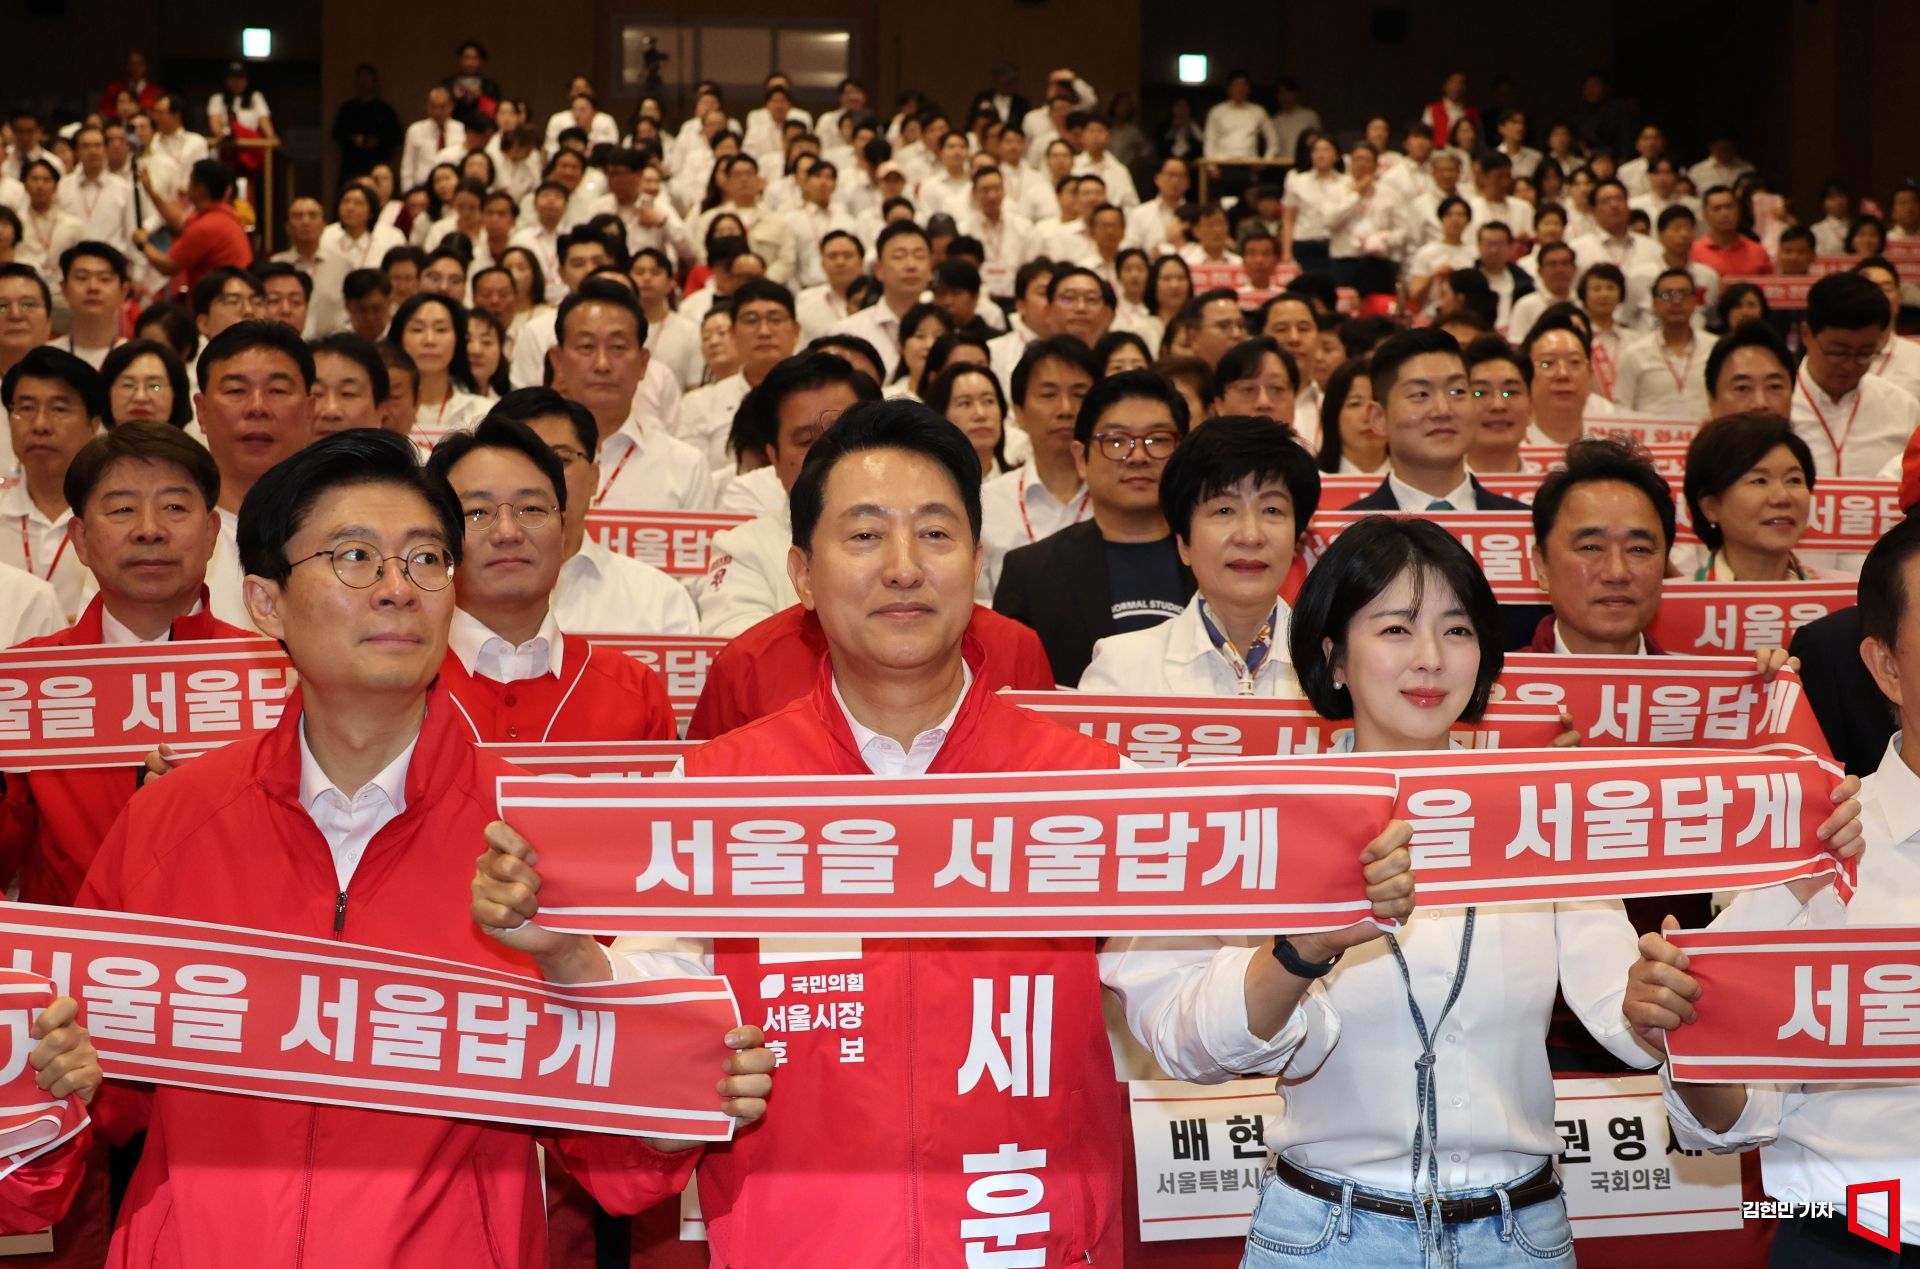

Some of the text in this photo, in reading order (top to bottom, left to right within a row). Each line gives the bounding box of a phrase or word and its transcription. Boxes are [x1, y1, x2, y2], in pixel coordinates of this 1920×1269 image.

[1588, 679, 1801, 743] 서울답게
[635, 807, 1279, 899] 서울을 서울답게
[1505, 773, 1802, 862] 서울답게
[762, 1001, 865, 1033] 서울시장
[791, 973, 864, 994] 국민의힘
[1777, 963, 1920, 1046] 서울
[280, 973, 616, 1088] 서울답게
[1590, 1167, 1672, 1193] 국회의원
